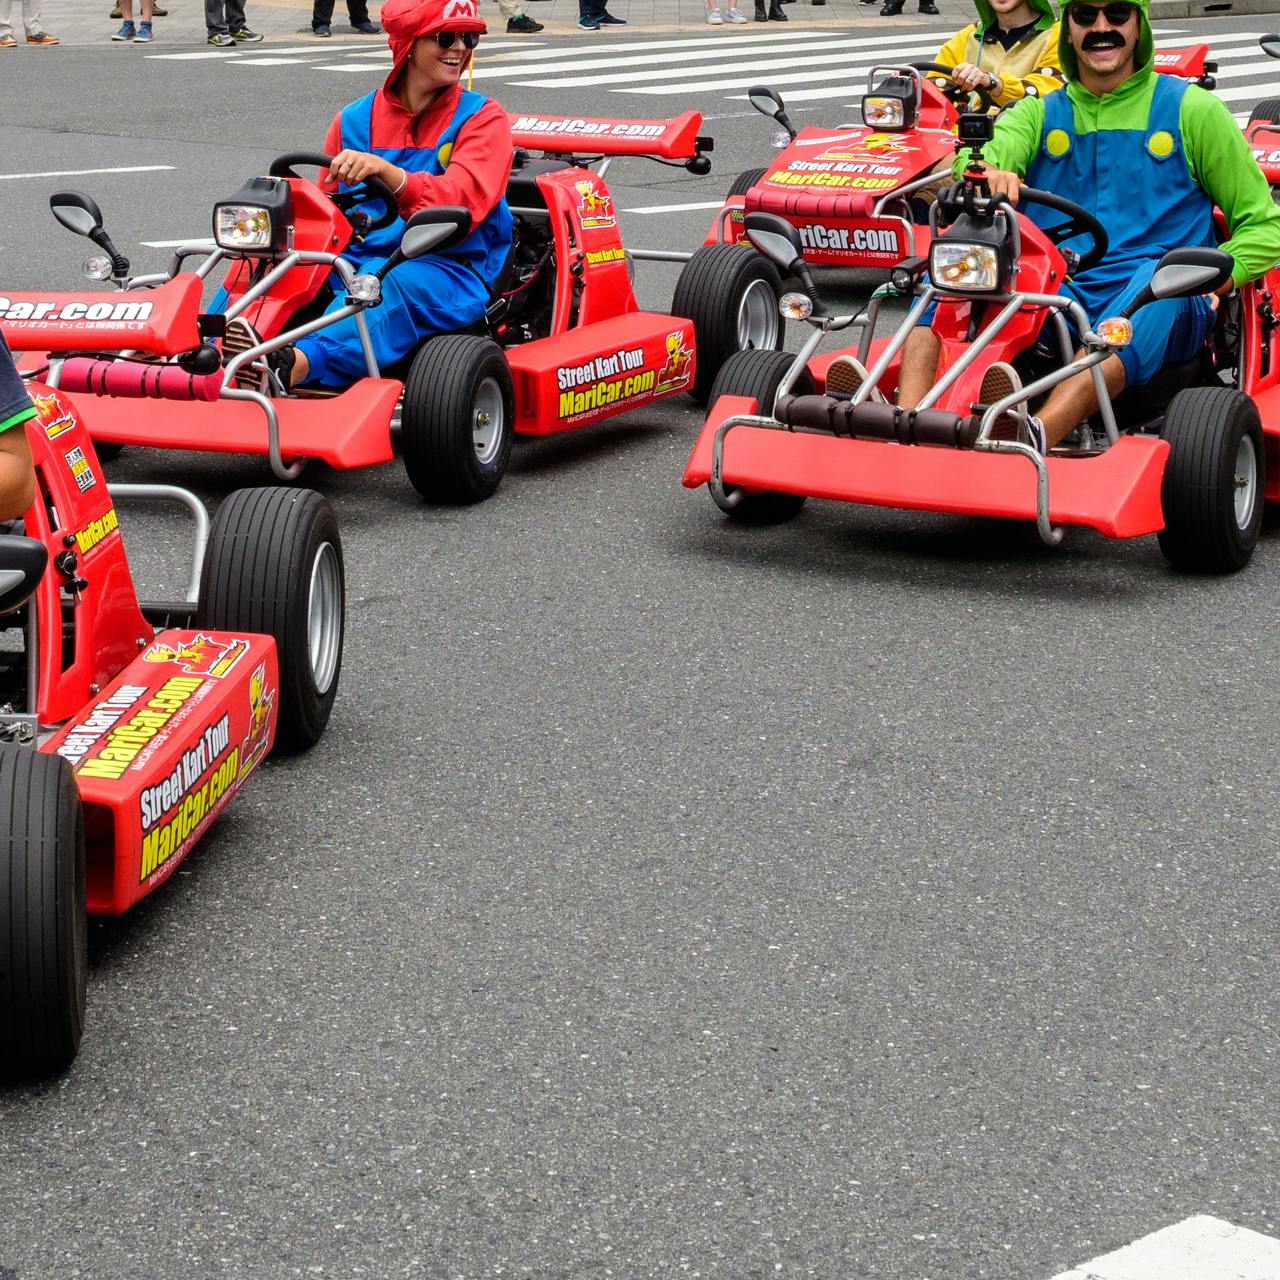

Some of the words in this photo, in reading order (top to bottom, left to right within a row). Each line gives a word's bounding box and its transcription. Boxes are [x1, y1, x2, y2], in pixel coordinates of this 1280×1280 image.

[449, 1, 472, 18] M
[511, 116, 667, 137] MariCar.com
[768, 170, 898, 189] MariCar.com
[788, 160, 835, 172] Street
[835, 161, 868, 174] Kart
[867, 162, 903, 176] Tour
[797, 224, 899, 252] riCar.com
[557, 363, 596, 390] Street
[595, 353, 620, 380] Kart
[618, 347, 644, 371] Tour
[558, 370, 656, 419] MariCar.com
[105, 683, 150, 715] Tour
[76, 675, 206, 780] MariCar.com
[140, 762, 184, 831] Street
[182, 741, 208, 789] Kart
[204, 713, 231, 766] Tour
[140, 745, 240, 883] MariCar.com
